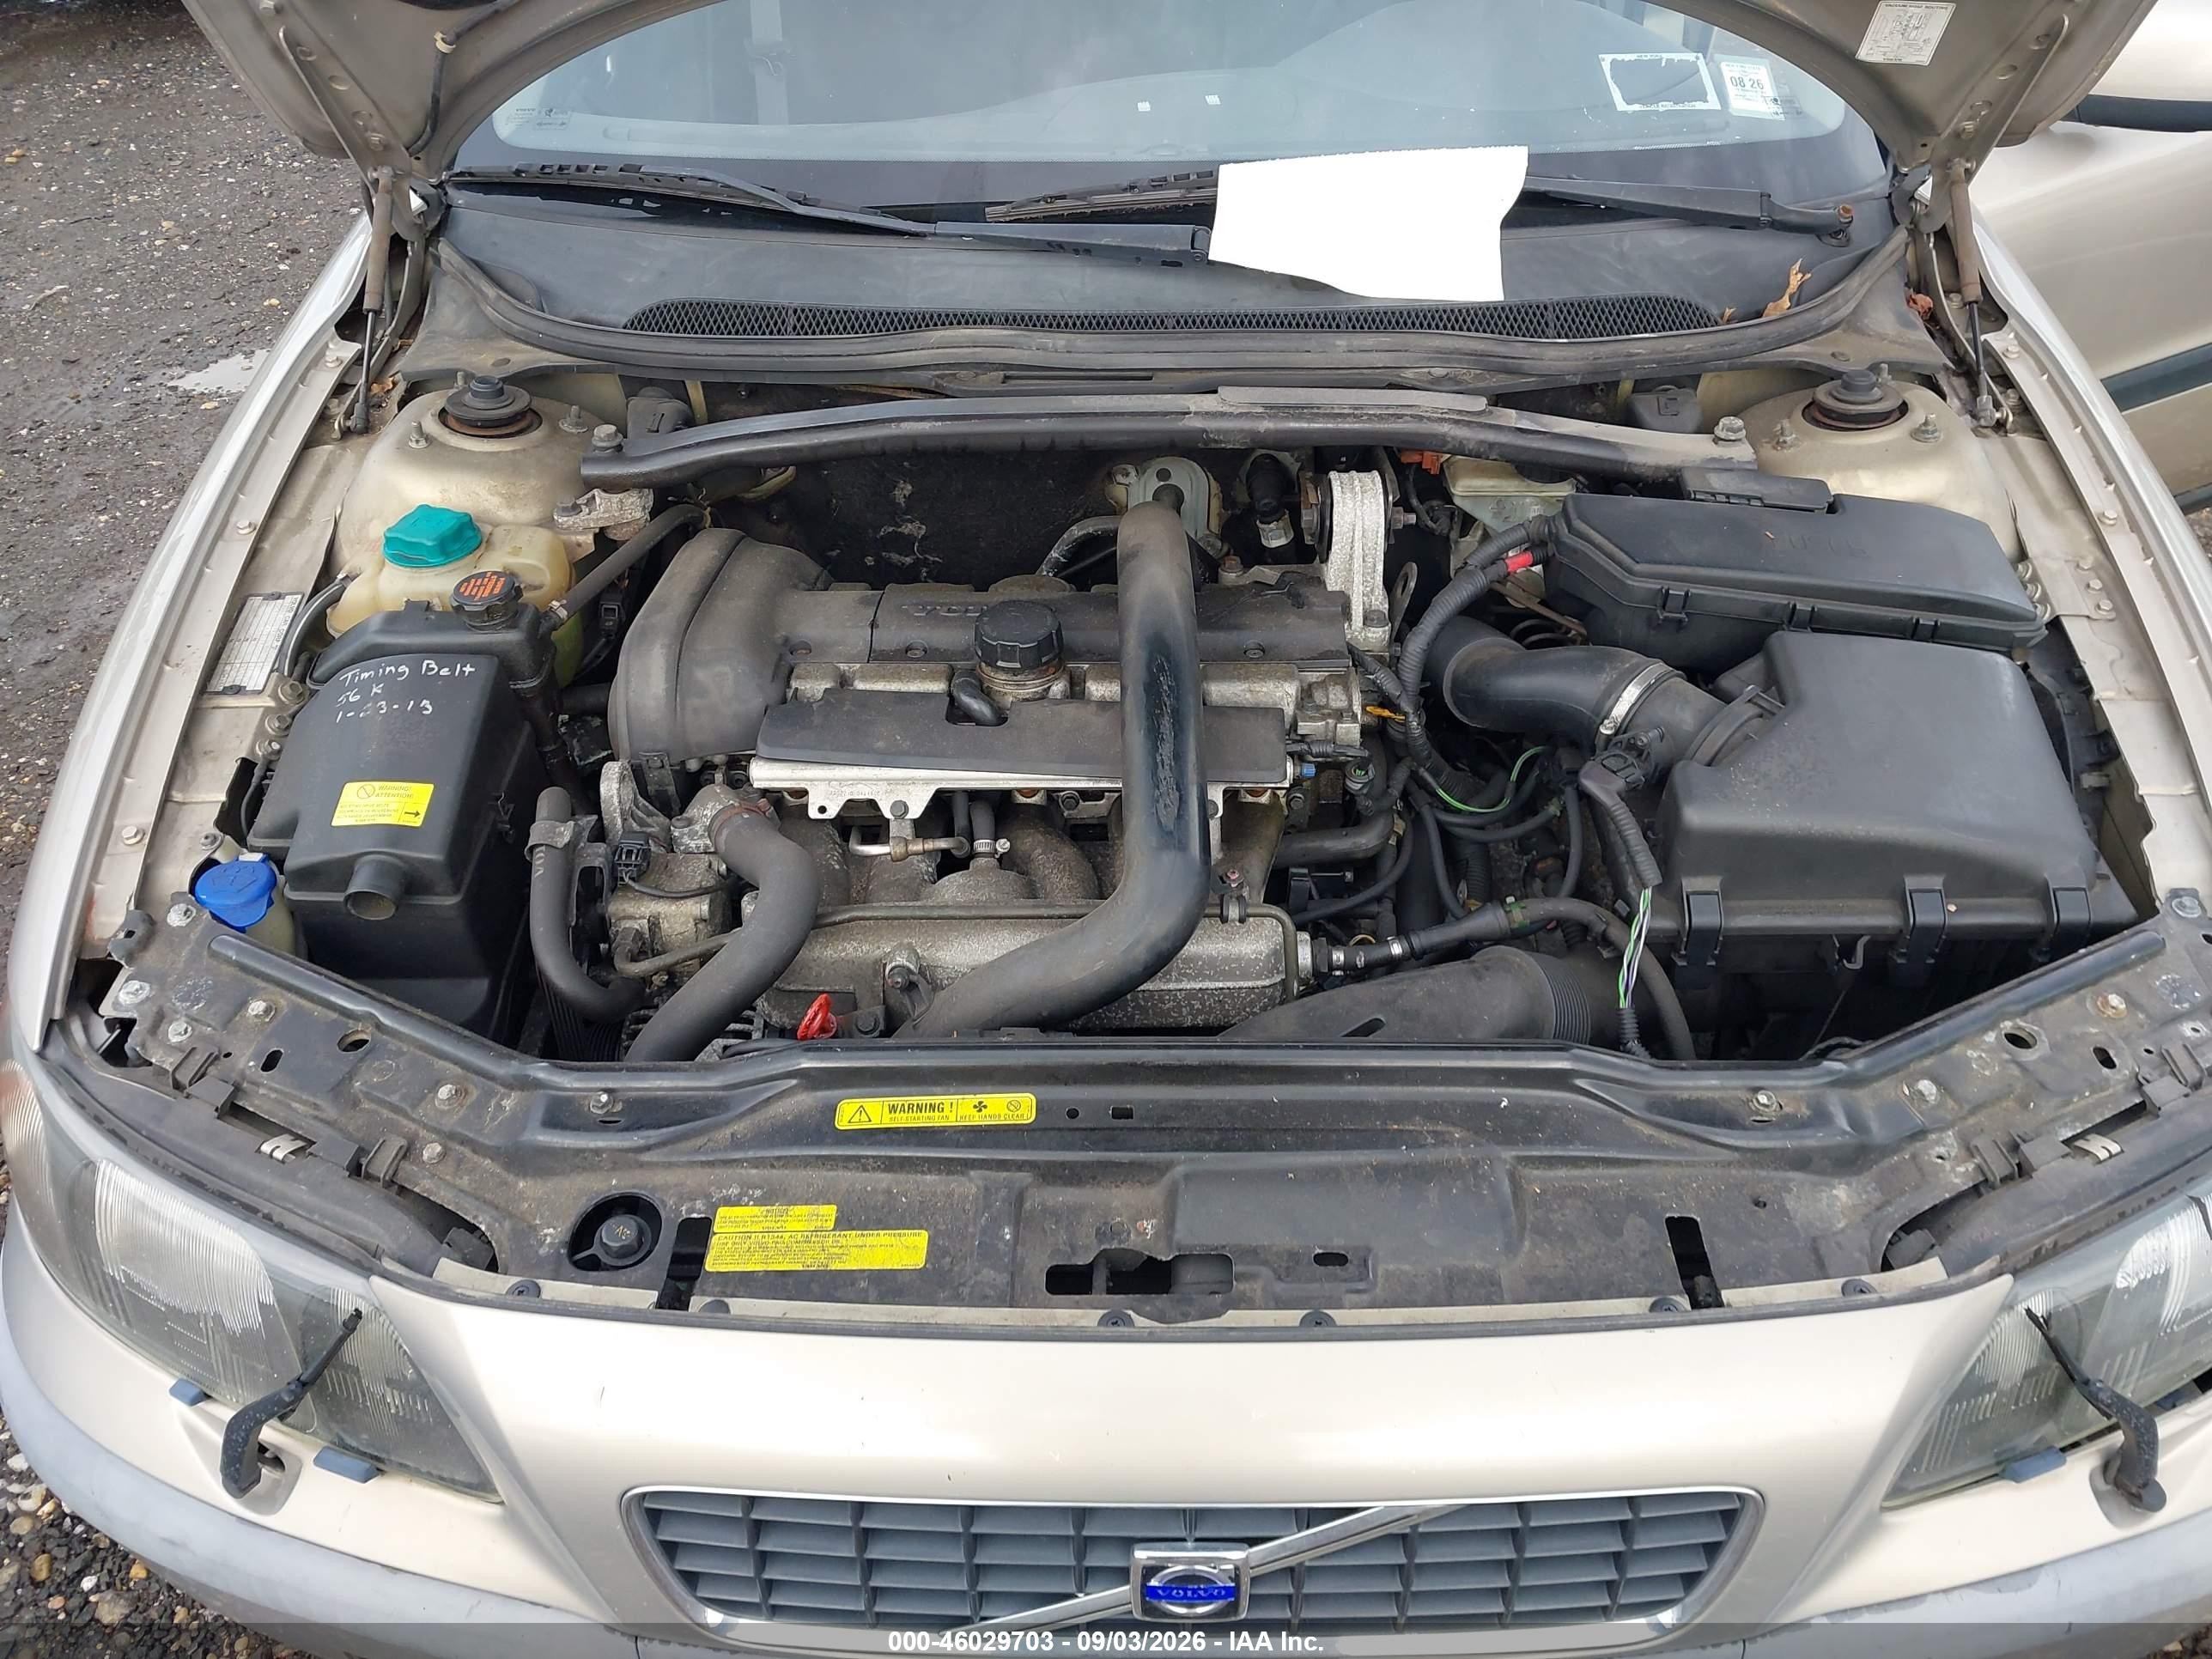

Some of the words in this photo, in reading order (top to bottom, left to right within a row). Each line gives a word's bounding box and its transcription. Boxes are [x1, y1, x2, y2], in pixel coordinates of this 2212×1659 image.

[1729, 76, 1746, 88] 08
[1748, 77, 1765, 89] 26
[339, 663, 410, 687] Timing
[421, 659, 476, 678] Belt
[888, 1102, 945, 1115] WARNING
[1157, 1589, 1226, 1598] VOLVO
